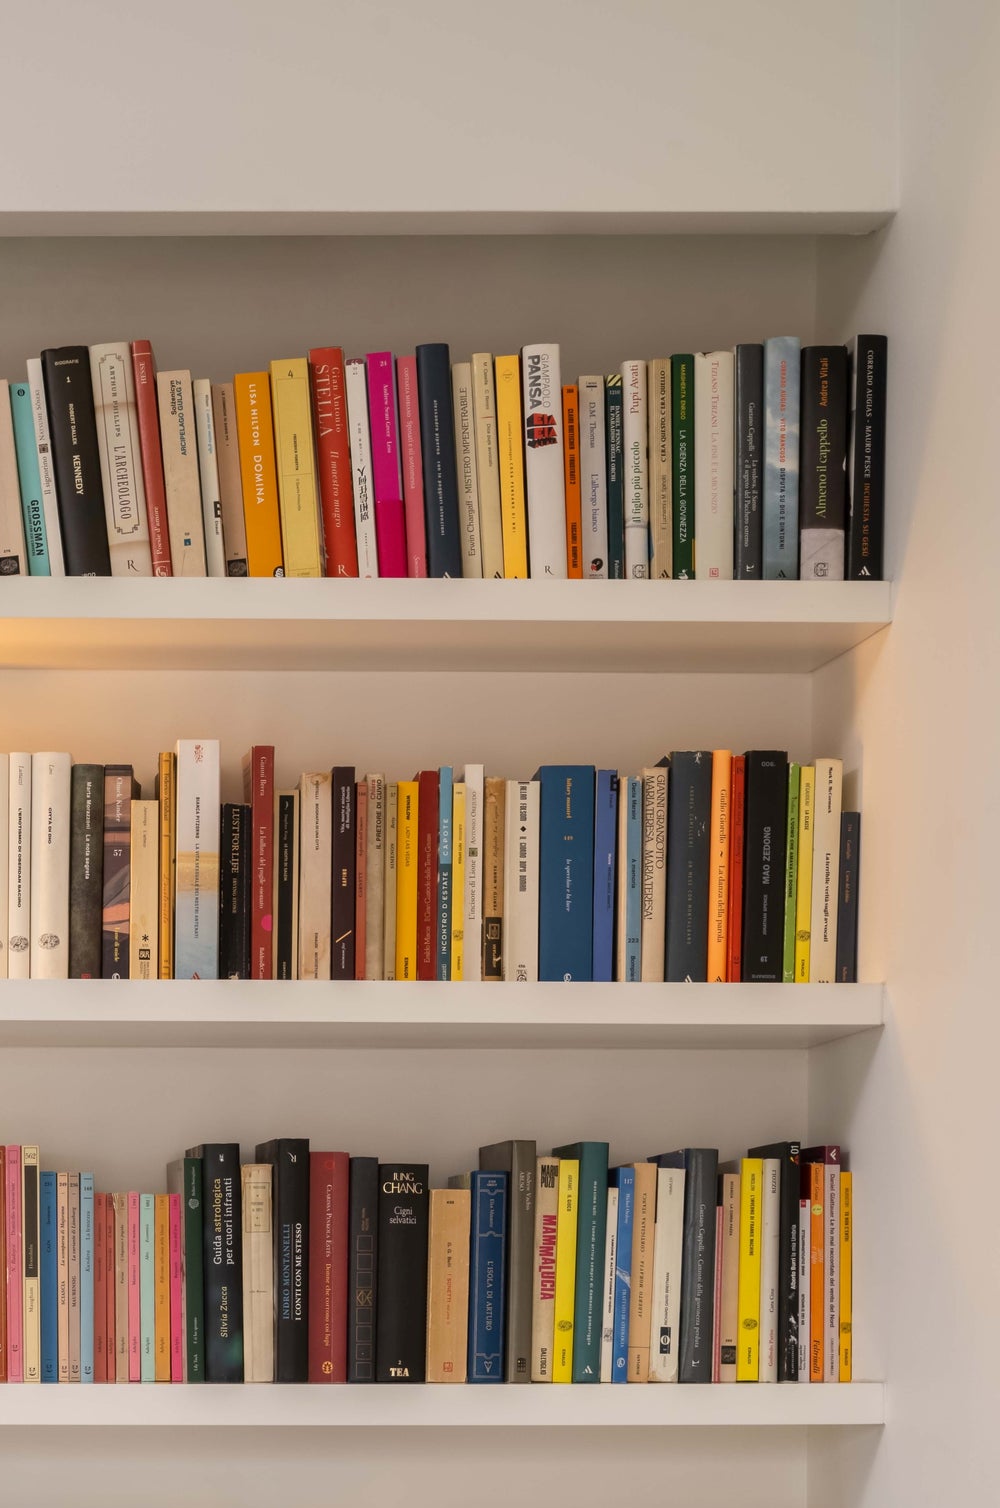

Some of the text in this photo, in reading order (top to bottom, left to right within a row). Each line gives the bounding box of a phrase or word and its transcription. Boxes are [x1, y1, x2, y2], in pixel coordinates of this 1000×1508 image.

[528, 355, 542, 409] PANSA
[541, 353, 550, 408] GIAMPAOLO
[819, 380, 827, 406] Andrea
[316, 364, 334, 437] STELLA
[630, 392, 639, 414] Pupi
[112, 400, 121, 437] PHILLIPS
[631, 441, 642, 473] piccolo
[817, 419, 830, 463] cappello
[74, 454, 84, 494] KENNEDY
[114, 446, 131, 519] L'ARCHEOLOGO
[254, 455, 264, 504] DOMINA
[632, 476, 642, 489] più
[632, 492, 642, 513] figlio
[816, 474, 826, 518] Almeno
[30, 500, 43, 555] GROSSMAN
[656, 813, 664, 869] GRANZOTTO
[791, 1145, 799, 1154] 01
[383, 1180, 422, 1193] CHANG
[393, 1172, 414, 1181] JUNG
[213, 1179, 223, 1264] Guida astrologica
[389, 1215, 416, 1224] selvatici
[394, 1206, 412, 1217] Cigni
[296, 1255, 301, 1266] ME
[389, 1368, 408, 1376] TEA
